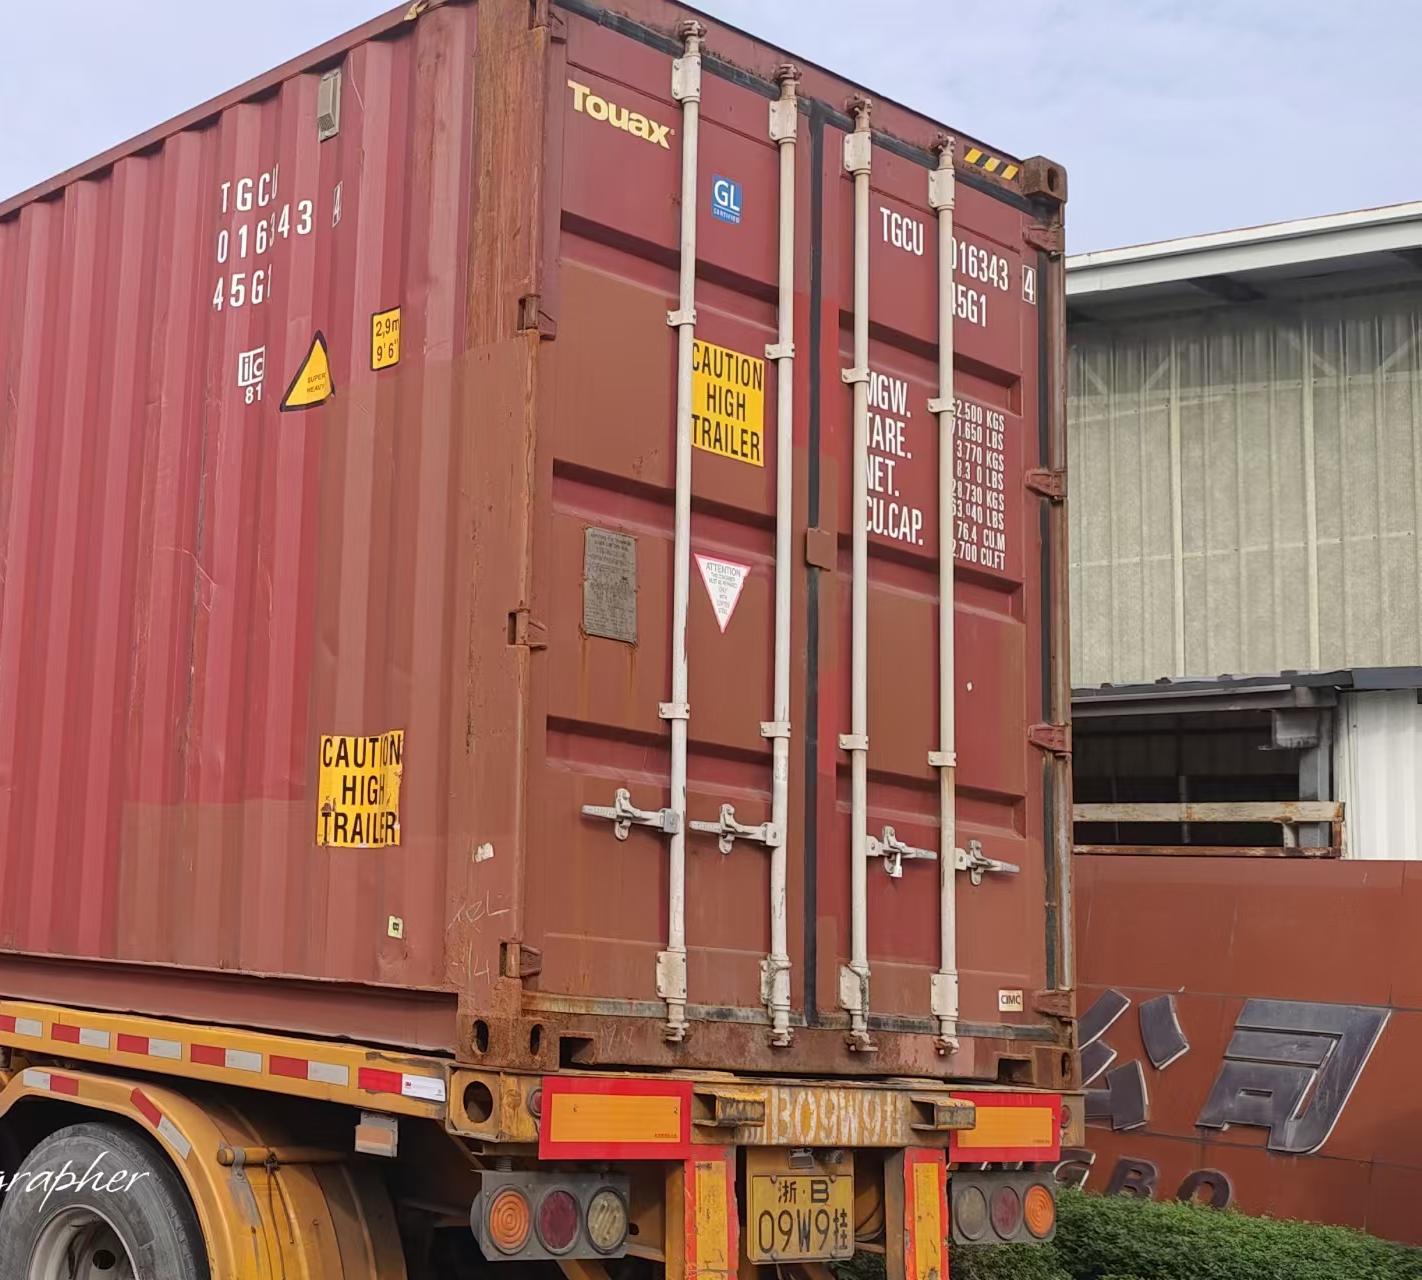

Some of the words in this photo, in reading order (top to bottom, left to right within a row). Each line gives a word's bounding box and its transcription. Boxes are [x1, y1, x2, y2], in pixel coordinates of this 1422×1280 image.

[567, 79, 671, 150] Touax
[221, 163, 278, 213] TGCU
[714, 180, 740, 212] GL
[217, 199, 313, 263] 016343
[880, 207, 923, 256] TGCU
[213, 264, 272, 312] 45G1
[1023, 267, 1035, 303] 4
[692, 342, 763, 392] CAUTION
[245, 383, 262, 404] 81
[706, 382, 746, 422] HIGH
[986, 410, 1004, 432] KGS
[692, 414, 760, 461] TRAILER
[986, 428, 1003, 450] LBS
[957, 440, 982, 464] 3.770
[986, 450, 1004, 471] KGS
[986, 468, 1003, 490] LBS
[986, 490, 1004, 511] KGS
[986, 509, 1004, 530] LBS
[957, 521, 977, 543] 76.4
[983, 529, 1005, 551] CU.M
[706, 562, 741, 577] ATTENTION
[980, 548, 1005, 570] CU.FT
[322, 734, 401, 768] CAUTION
[342, 774, 385, 806] HIGH
[322, 811, 396, 843] TRAILER
[1000, 994, 1022, 1006] CIMC
[758, 1208, 848, 1254] 09W9挂
